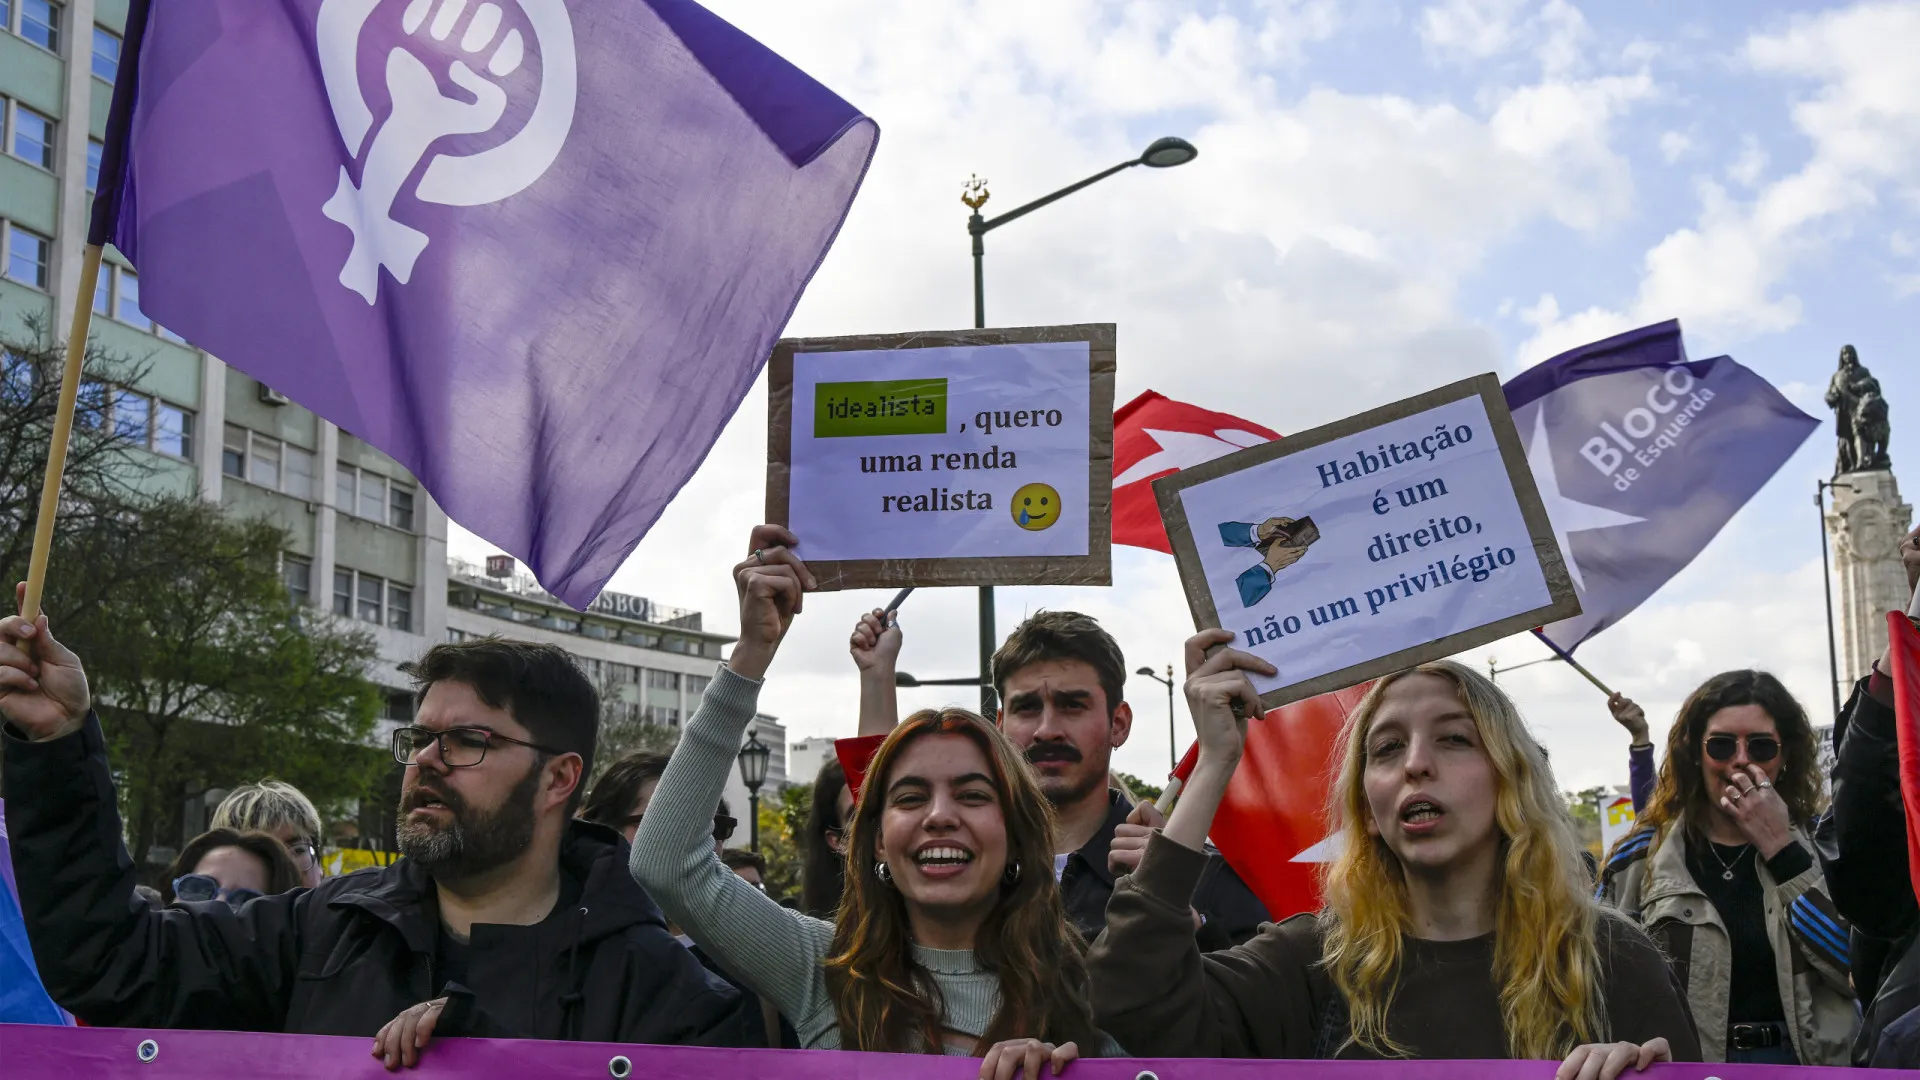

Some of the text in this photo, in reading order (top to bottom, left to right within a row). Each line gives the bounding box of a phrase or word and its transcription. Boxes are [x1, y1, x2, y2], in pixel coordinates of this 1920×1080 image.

[827, 395, 935, 419] idealista
[974, 408, 1063, 435] quero
[859, 445, 1017, 474] uma renda
[1315, 424, 1473, 488] Habitação
[1613, 387, 1716, 491] de Esquerda
[881, 488, 993, 513] realista
[1372, 477, 1449, 515] é um
[1367, 515, 1482, 563] direito,
[1243, 545, 1517, 648] não um privilégio
